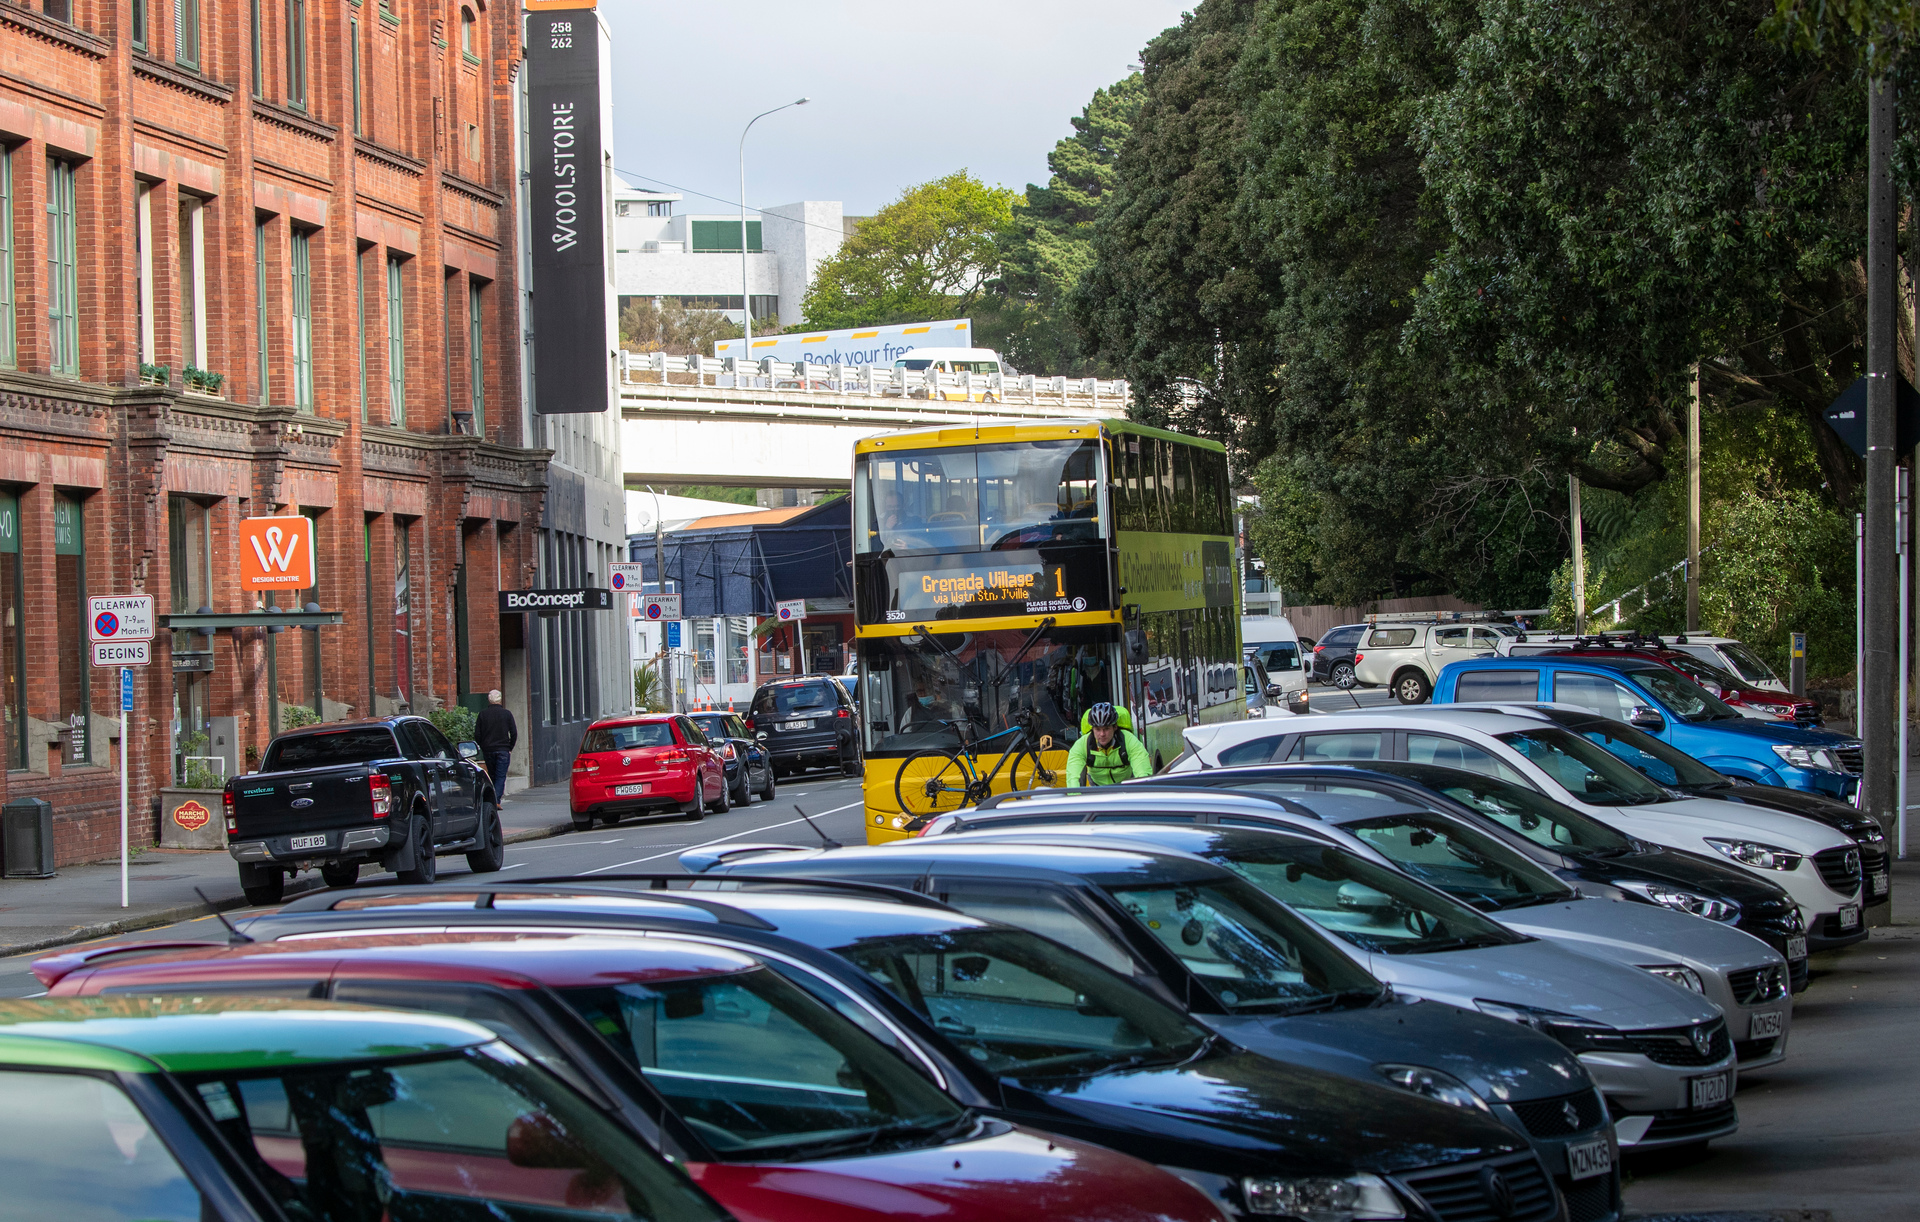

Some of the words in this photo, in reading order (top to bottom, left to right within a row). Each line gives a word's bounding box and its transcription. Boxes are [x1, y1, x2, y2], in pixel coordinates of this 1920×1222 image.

[551, 22, 572, 33] 258
[551, 38, 573, 49] 262
[552, 102, 577, 252] WOOLSTORE
[803, 349, 841, 365] Book
[845, 349, 880, 367] your
[922, 573, 984, 593] Grenada
[988, 571, 1034, 589] Village
[1054, 567, 1066, 597] 1
[933, 592, 949, 605] via
[951, 590, 975, 604] Wgtn
[1001, 588, 1029, 600] J'ville
[94, 600, 147, 610] CLEARWAY
[124, 615, 146, 624] 7-9am
[886, 612, 905, 620] 3520
[121, 627, 149, 635] Mon-Fri
[99, 647, 145, 660] BEGINS
[292, 837, 325, 849] HUF109
[1753, 1017, 1781, 1036] NDN594
[1571, 1143, 1610, 1173] MZN435
